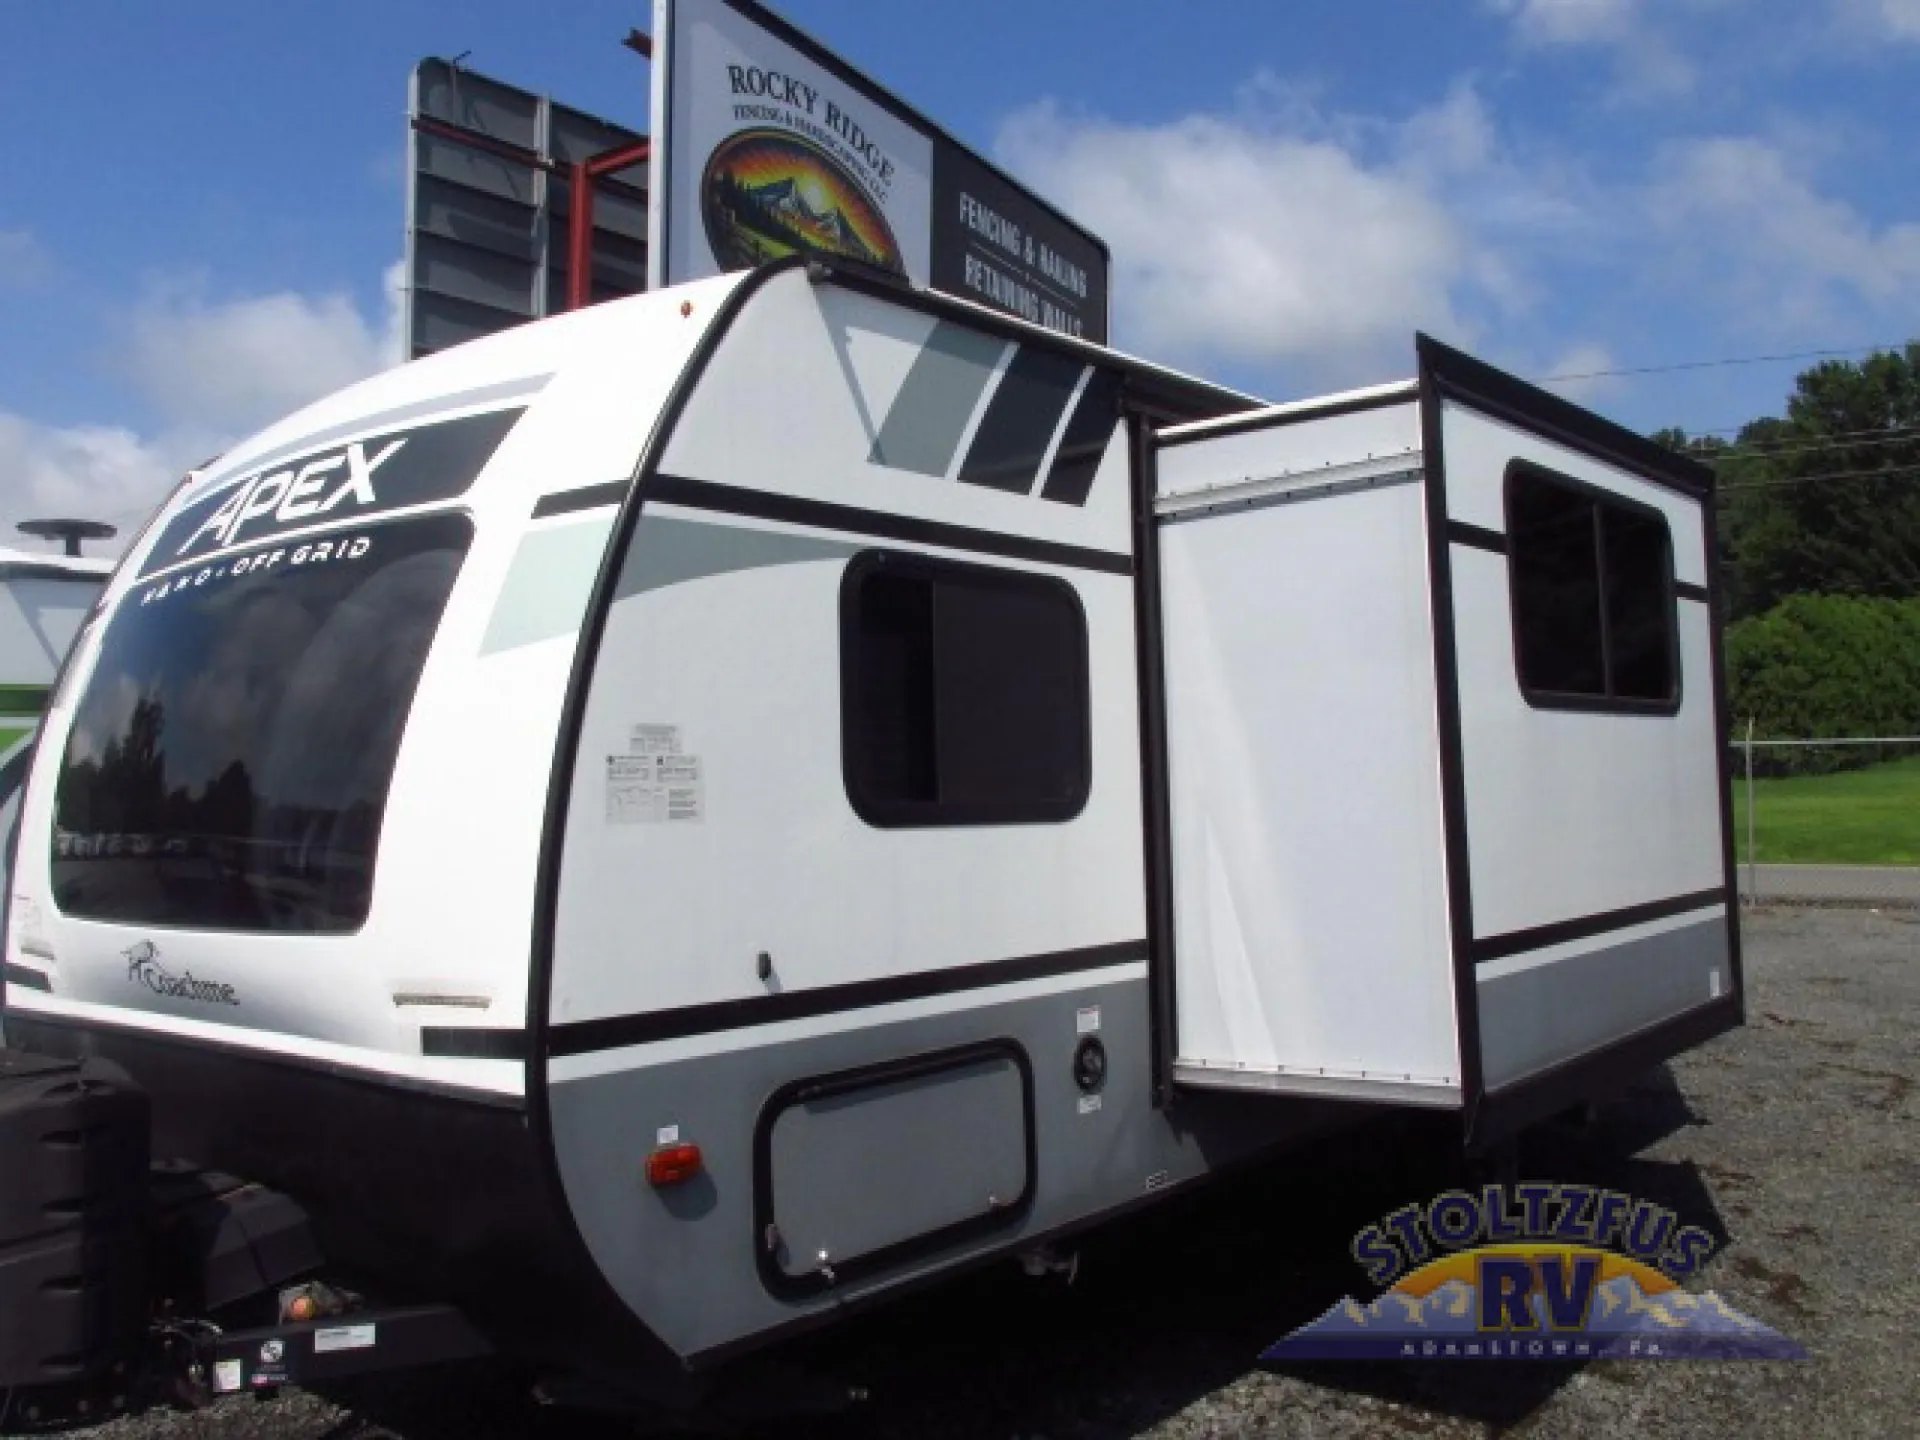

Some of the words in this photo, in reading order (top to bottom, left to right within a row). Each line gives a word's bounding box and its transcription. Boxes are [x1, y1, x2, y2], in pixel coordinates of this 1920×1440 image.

[726, 65, 819, 114] ROCKY
[824, 101, 895, 184] RIDGE
[960, 191, 1021, 256] FENCING
[1023, 236, 1036, 268] &
[965, 253, 1039, 322] RETAINING
[176, 438, 408, 556] APEX
[291, 537, 372, 565] GRID
